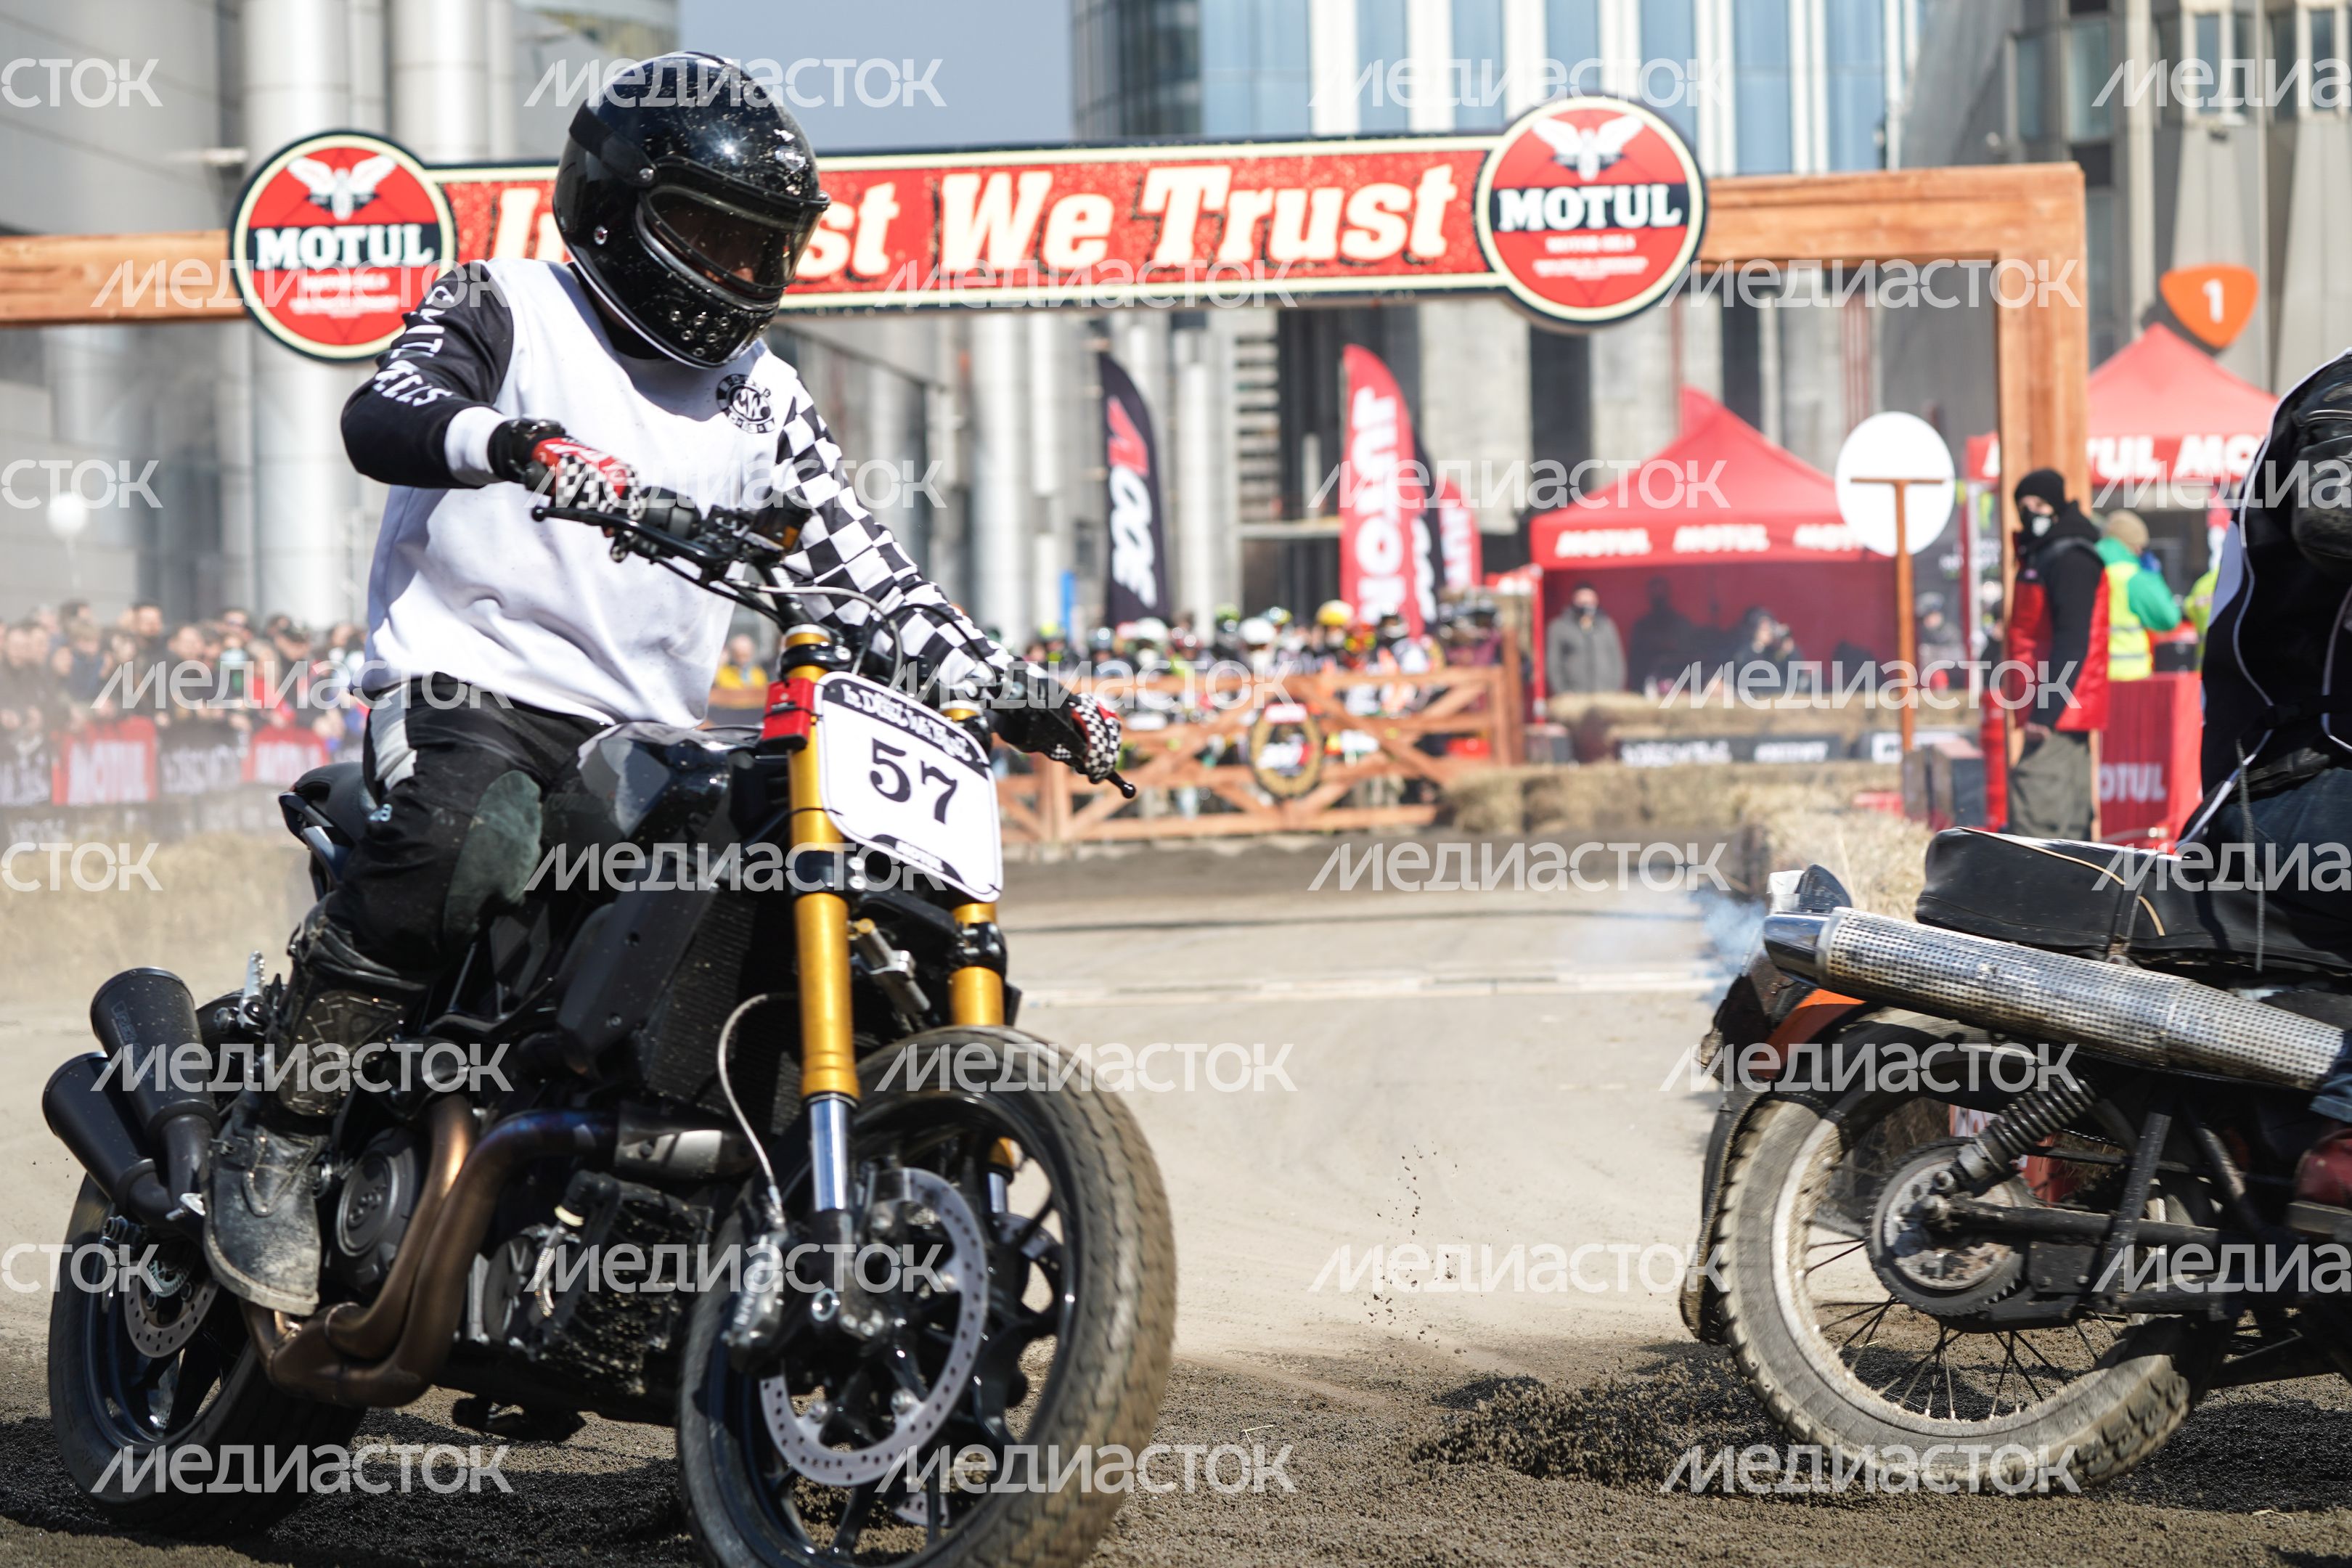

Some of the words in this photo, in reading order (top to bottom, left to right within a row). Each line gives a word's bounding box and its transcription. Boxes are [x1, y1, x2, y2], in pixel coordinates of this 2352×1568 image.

[941, 171, 1115, 272] We
[1141, 163, 1459, 269] Trust
[1497, 182, 1683, 232] MOTUL
[254, 224, 436, 271] MOTUL
[2202, 278, 2225, 324] 1
[869, 738, 957, 825] 57
[2099, 763, 2167, 803] OTUL
